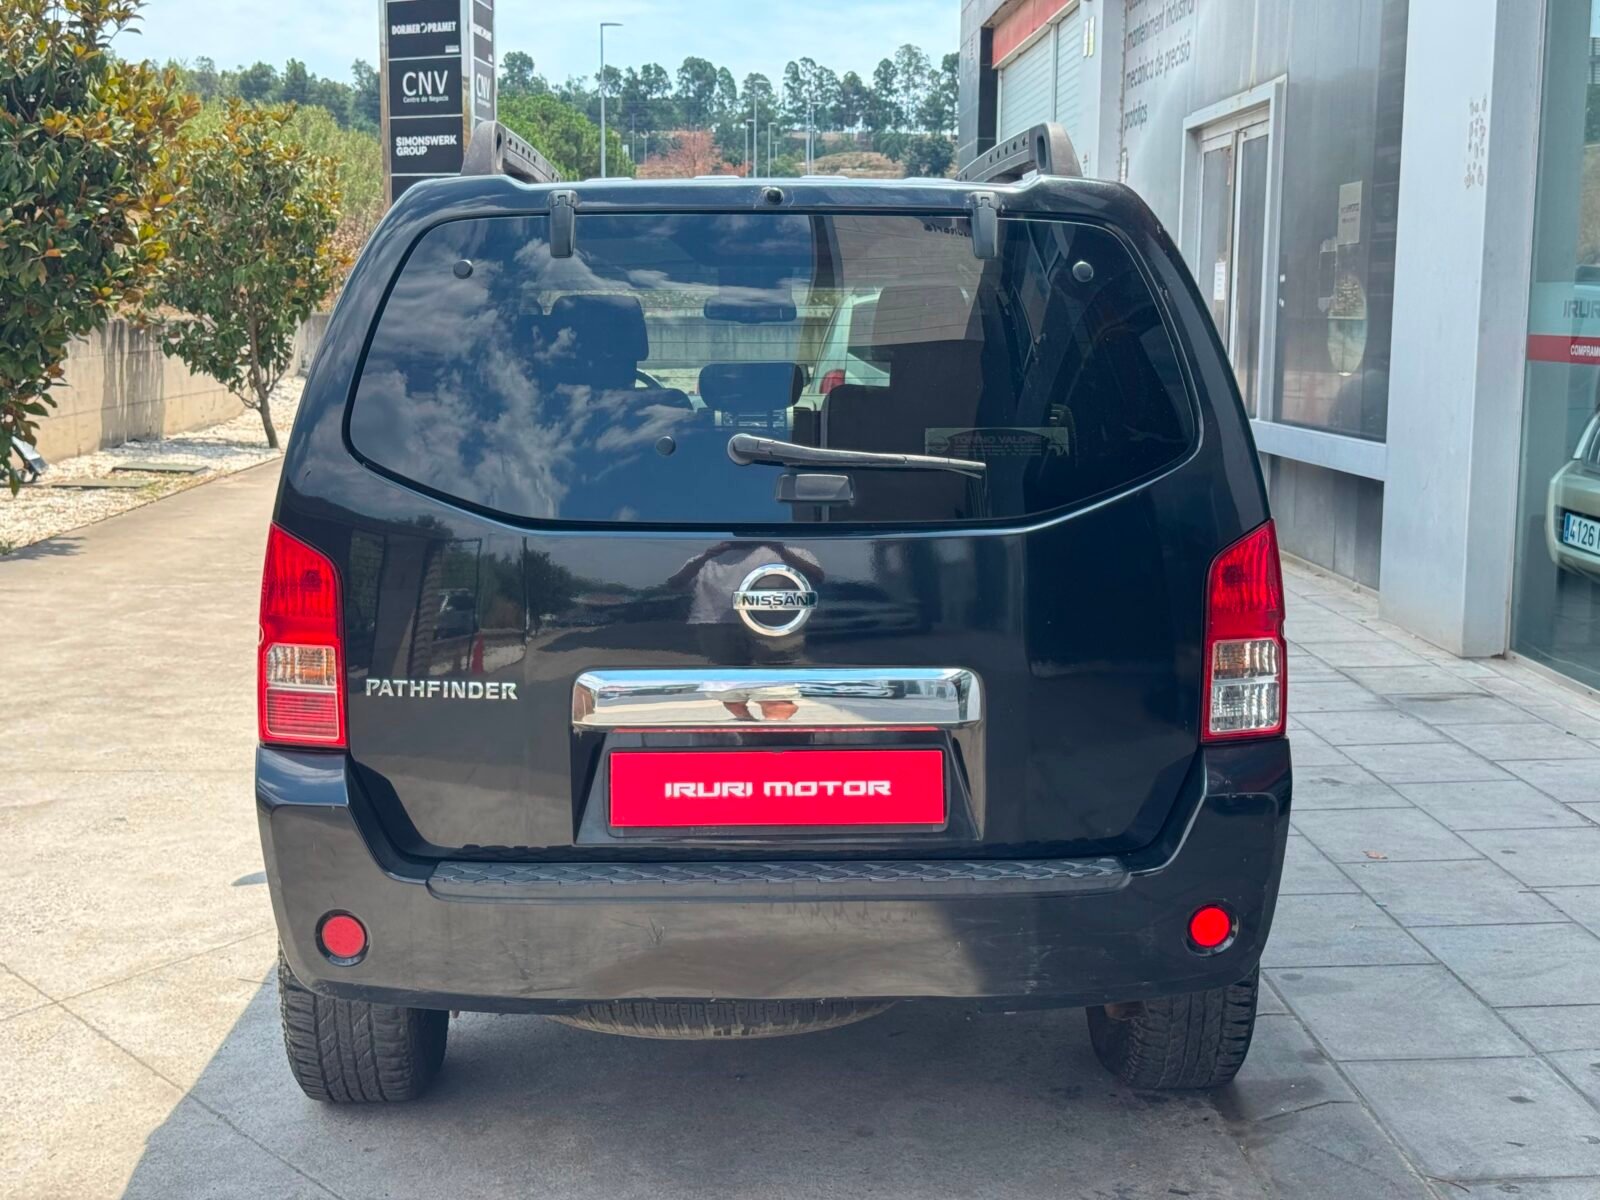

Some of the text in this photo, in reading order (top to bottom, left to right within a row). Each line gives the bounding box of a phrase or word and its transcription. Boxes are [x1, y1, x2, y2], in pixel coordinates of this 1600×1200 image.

[1154, 49, 1164, 77] de
[402, 70, 449, 96] CNV
[396, 135, 457, 146] SIMONSWERK
[396, 146, 428, 157] GROUP
[741, 595, 808, 606] NISSAN
[365, 678, 518, 701] PATHFINDER
[664, 779, 892, 800] IRURI MOTOR
